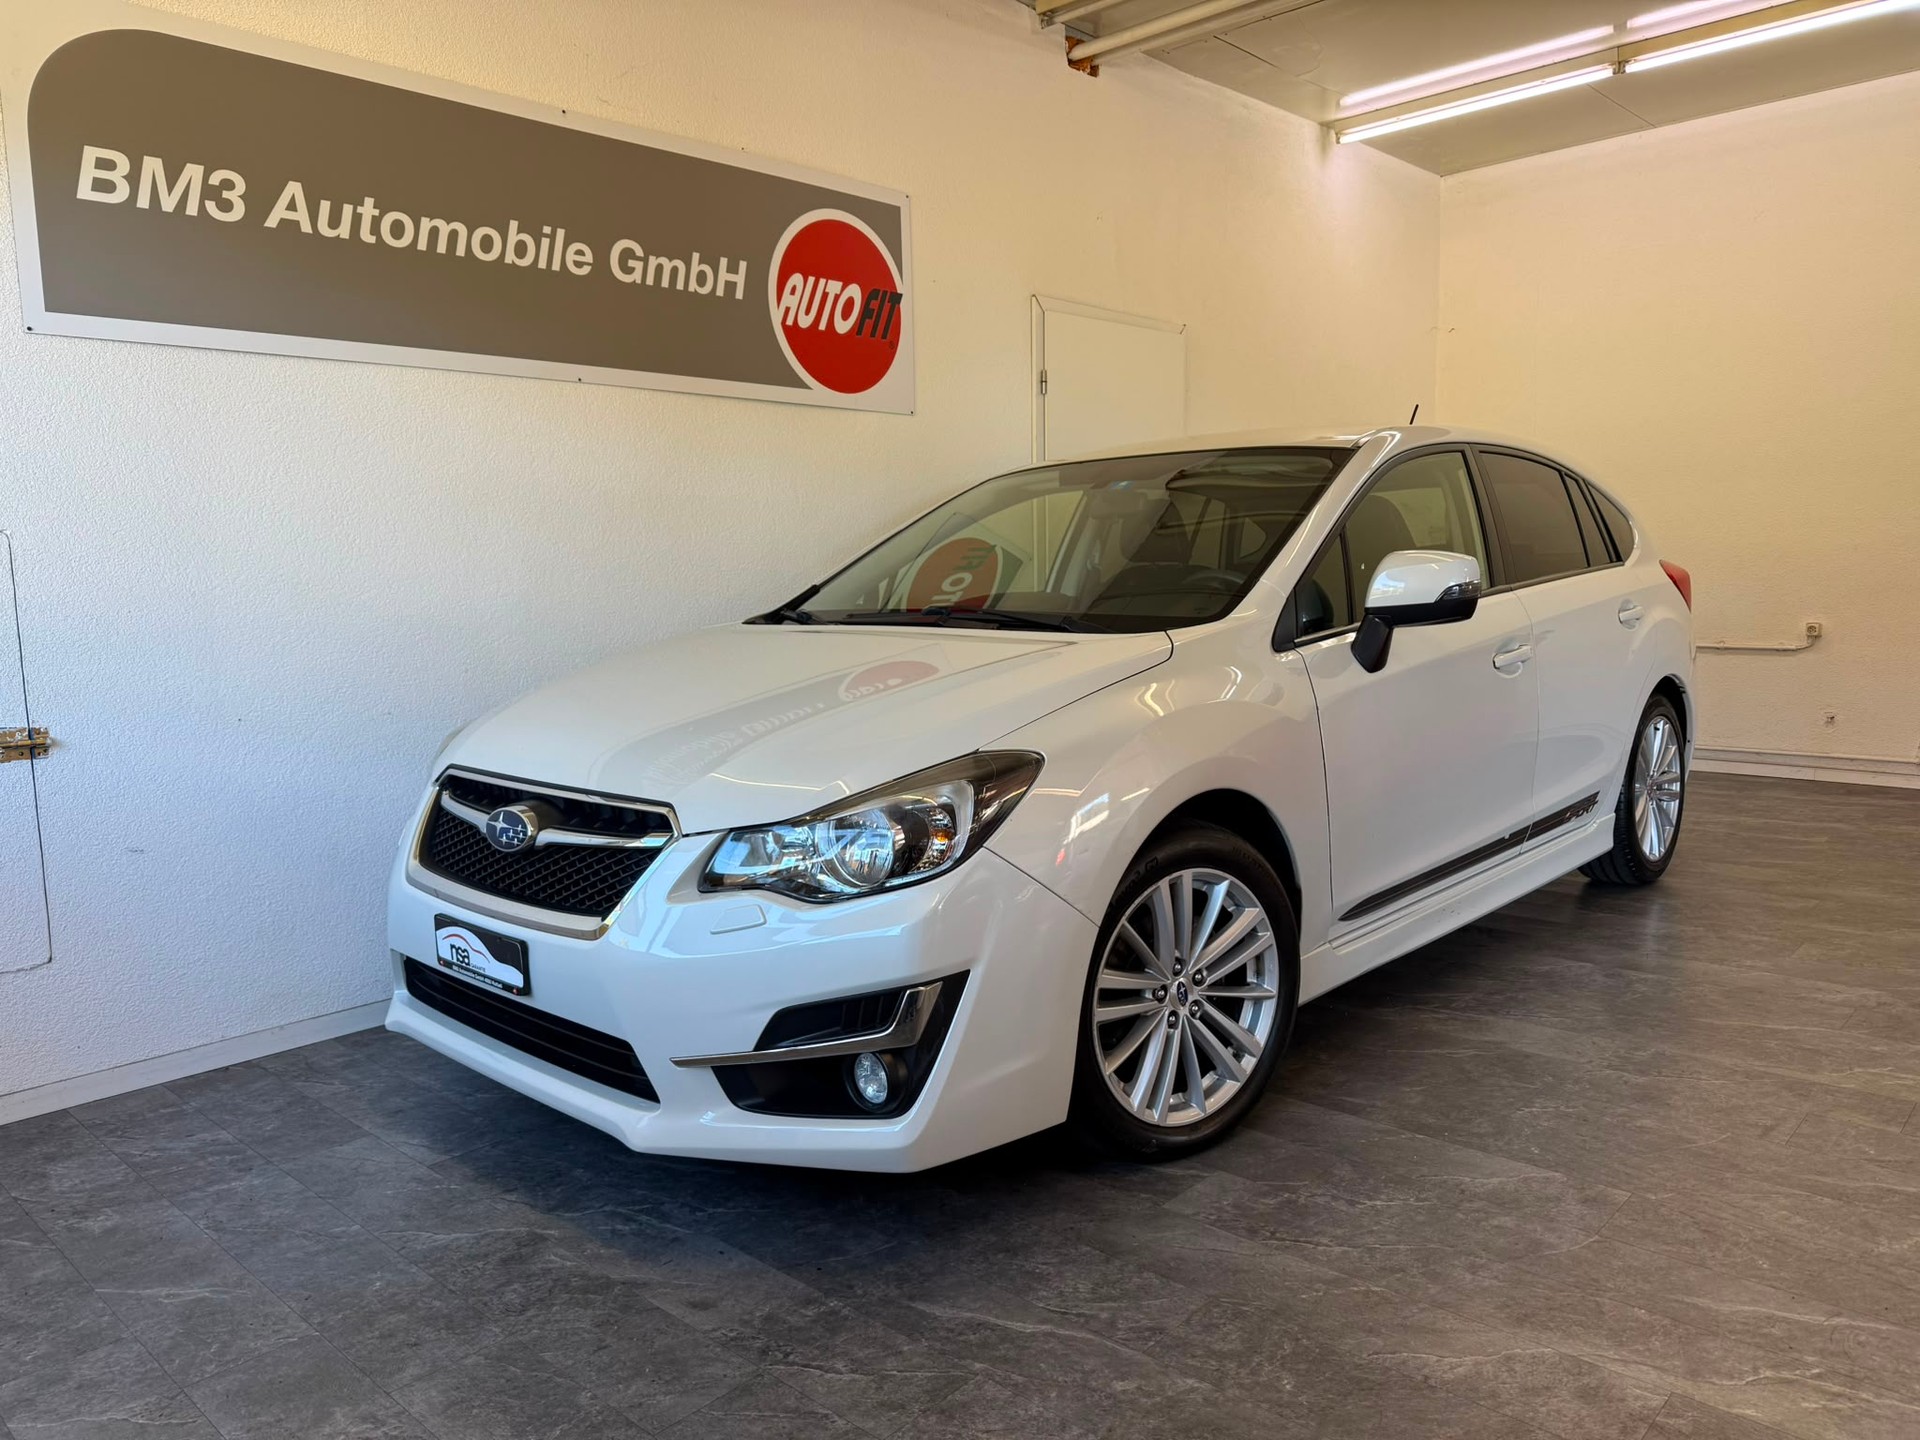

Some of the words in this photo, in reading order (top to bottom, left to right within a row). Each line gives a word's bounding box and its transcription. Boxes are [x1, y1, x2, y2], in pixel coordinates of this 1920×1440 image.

[76, 145, 247, 223] BM3
[264, 180, 594, 276] Automobile
[610, 238, 747, 300] GmbH
[779, 272, 903, 340] AUTOFIT
